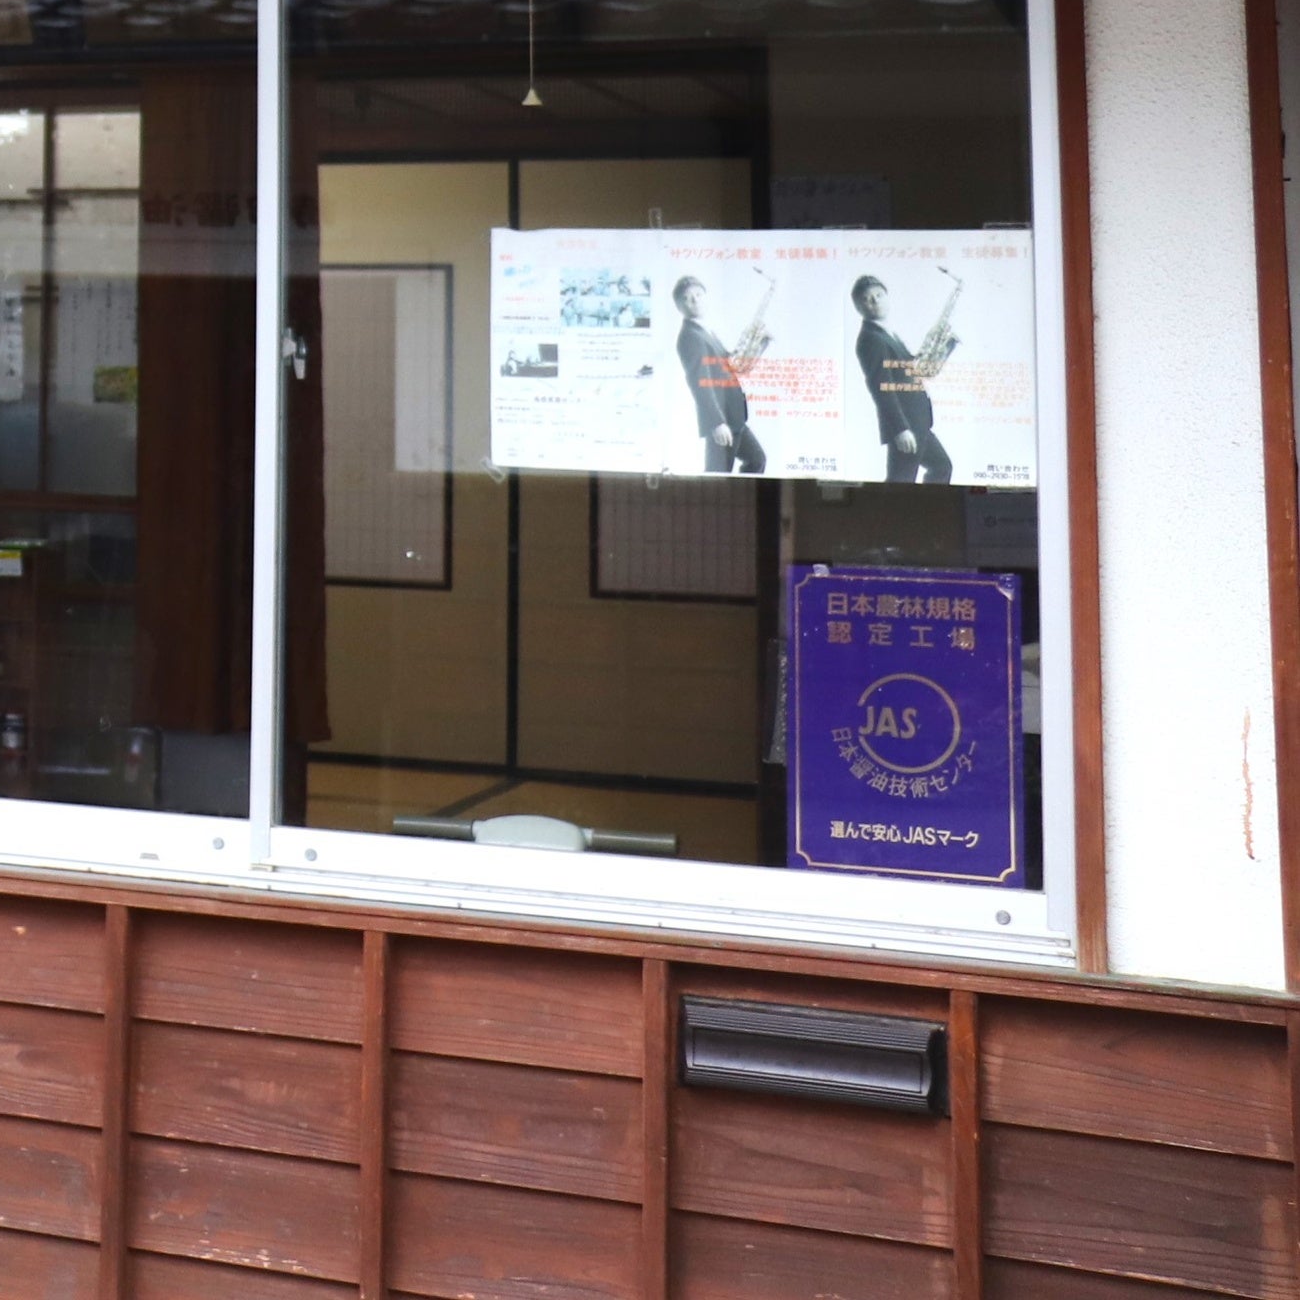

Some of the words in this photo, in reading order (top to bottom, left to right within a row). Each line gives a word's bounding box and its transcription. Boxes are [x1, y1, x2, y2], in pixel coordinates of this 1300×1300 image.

[827, 593, 976, 622] 日本農林規格
[827, 621, 976, 650] 認定工場
[859, 705, 918, 739] JAS
[831, 726, 977, 798] 日本醤油技術センター
